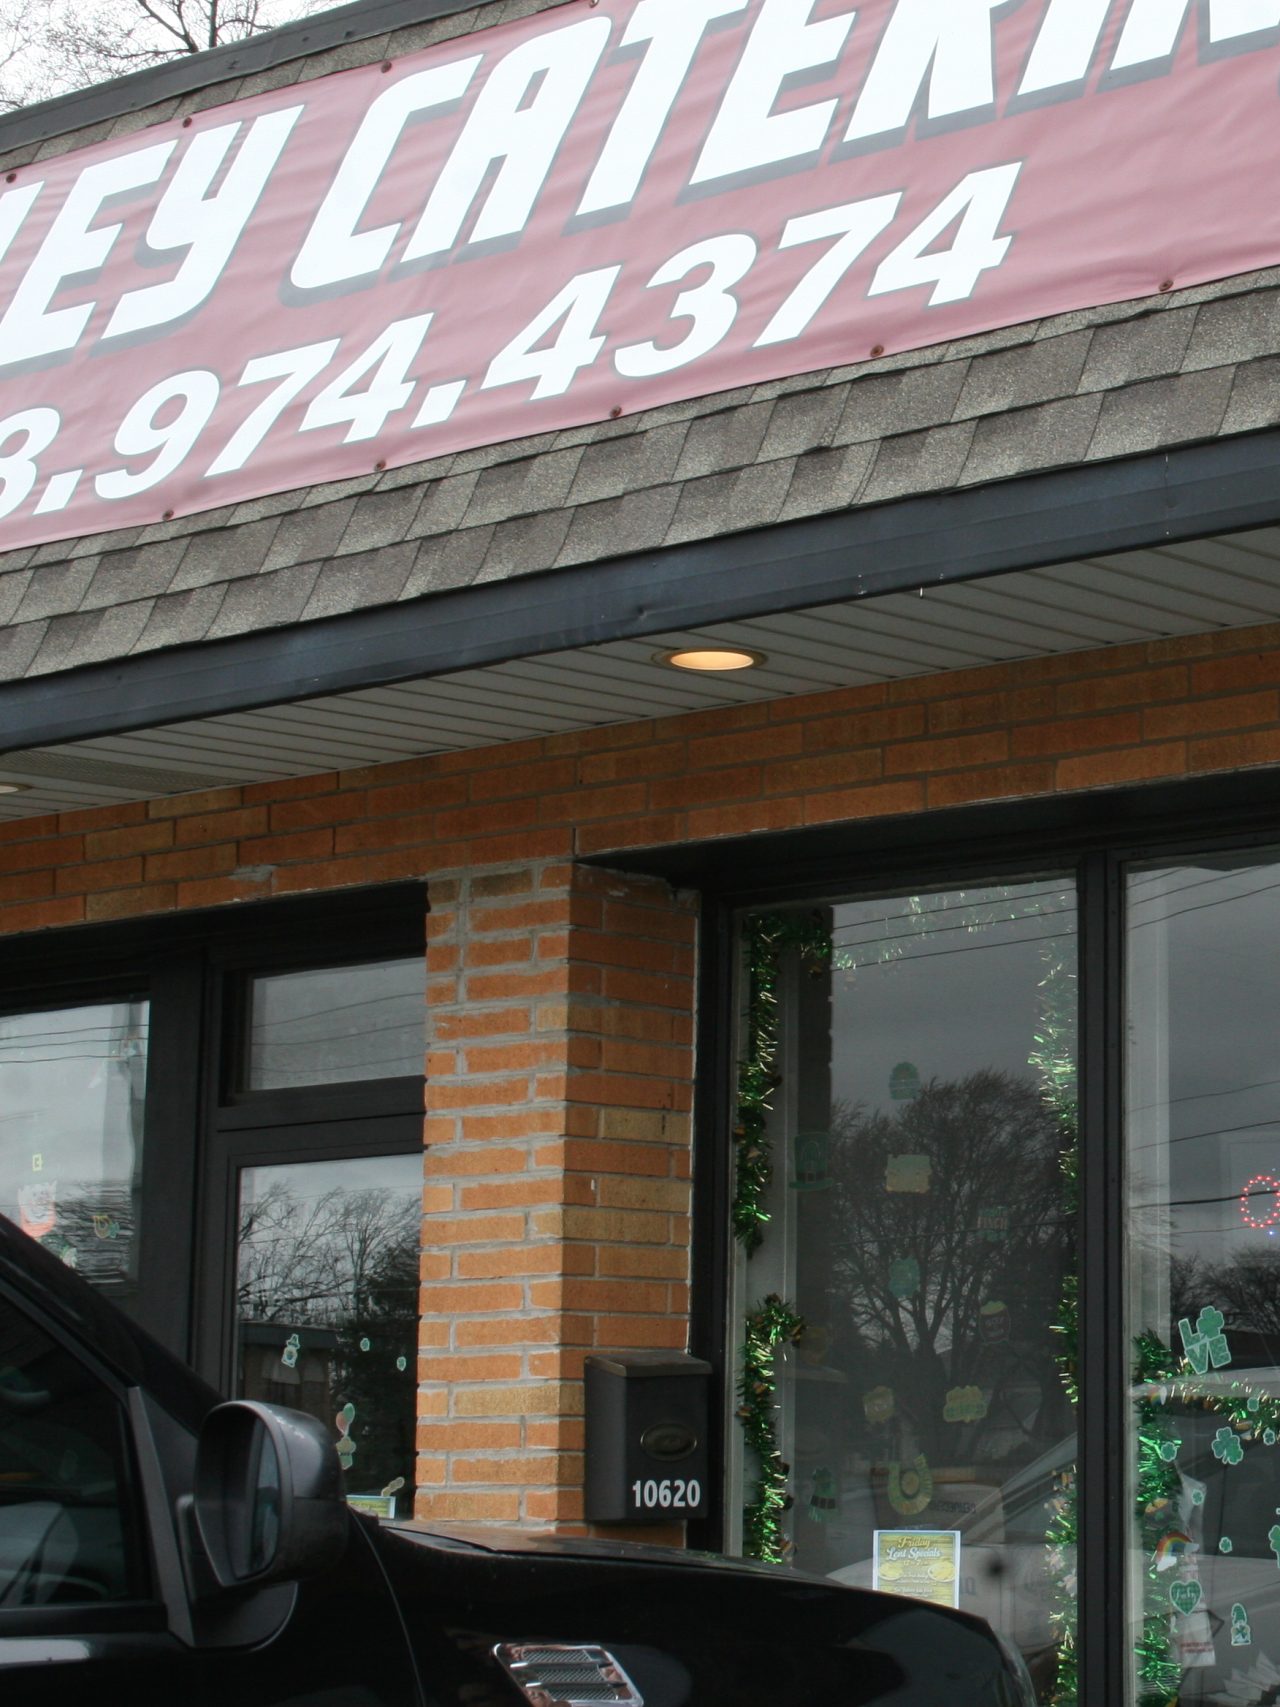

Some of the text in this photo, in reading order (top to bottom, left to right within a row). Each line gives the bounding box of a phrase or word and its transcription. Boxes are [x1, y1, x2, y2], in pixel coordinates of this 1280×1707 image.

[632, 1479, 701, 1508] 10620
[898, 1536, 931, 1549] Friday
[886, 1546, 906, 1561] Lent
